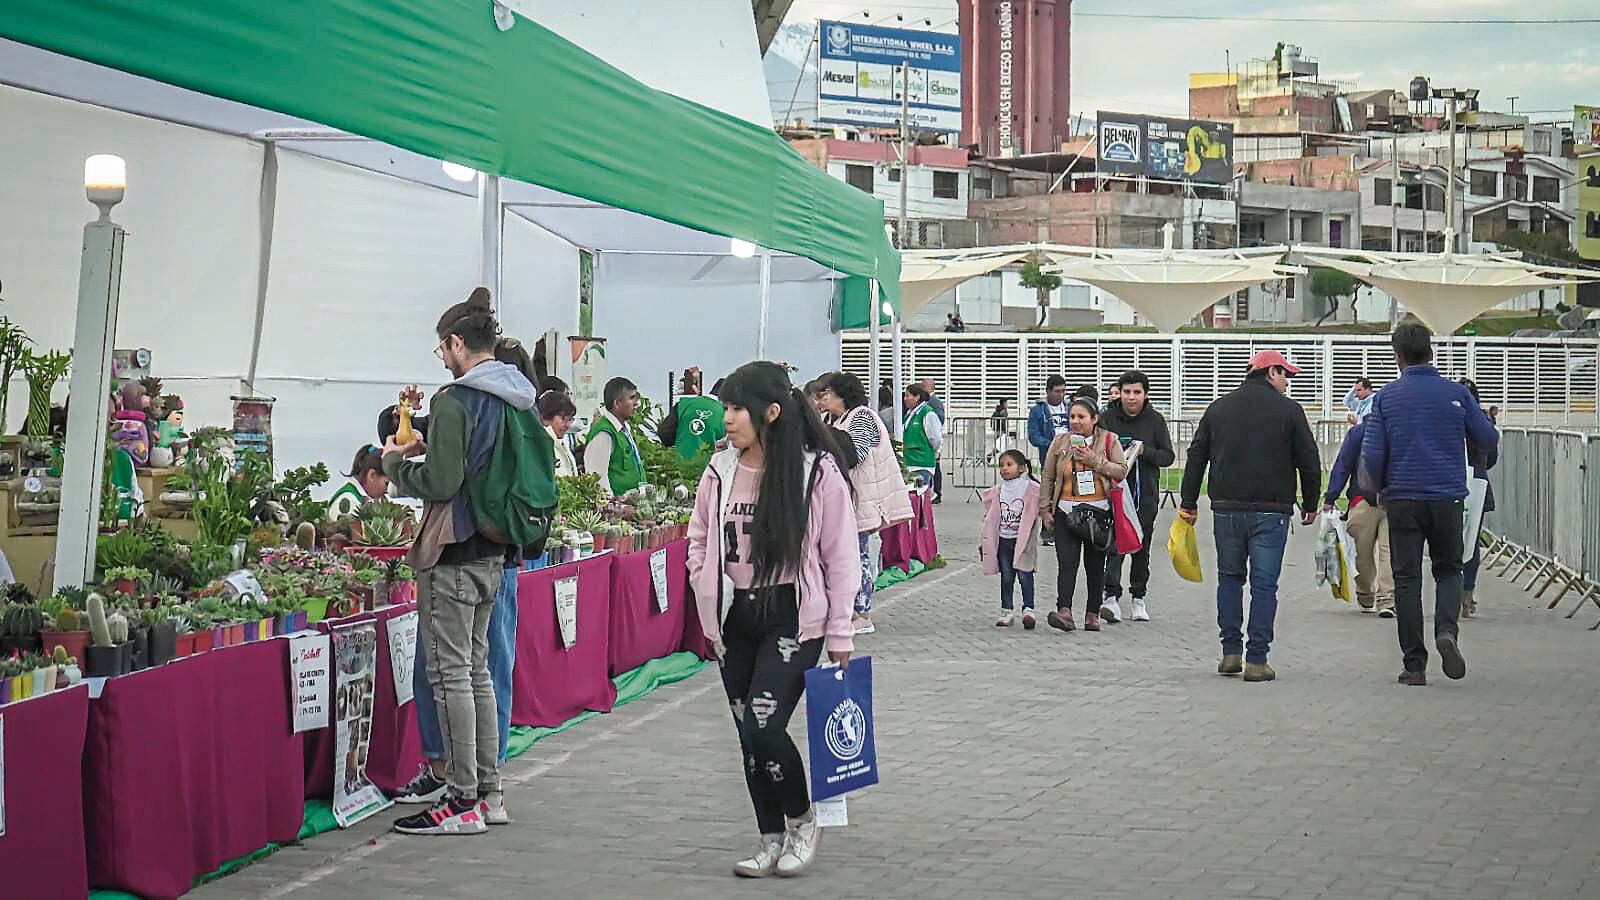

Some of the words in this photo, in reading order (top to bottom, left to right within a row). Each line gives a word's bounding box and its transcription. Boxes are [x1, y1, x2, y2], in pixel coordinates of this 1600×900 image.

[999, 2, 1011, 38] DAÑINO
[852, 34, 908, 48] INTERNATIONAL
[910, 40, 933, 51] WHEEL
[1000, 40, 1011, 50] ES
[1000, 52, 1011, 85] EXCESO
[1000, 87, 1011, 99] EN
